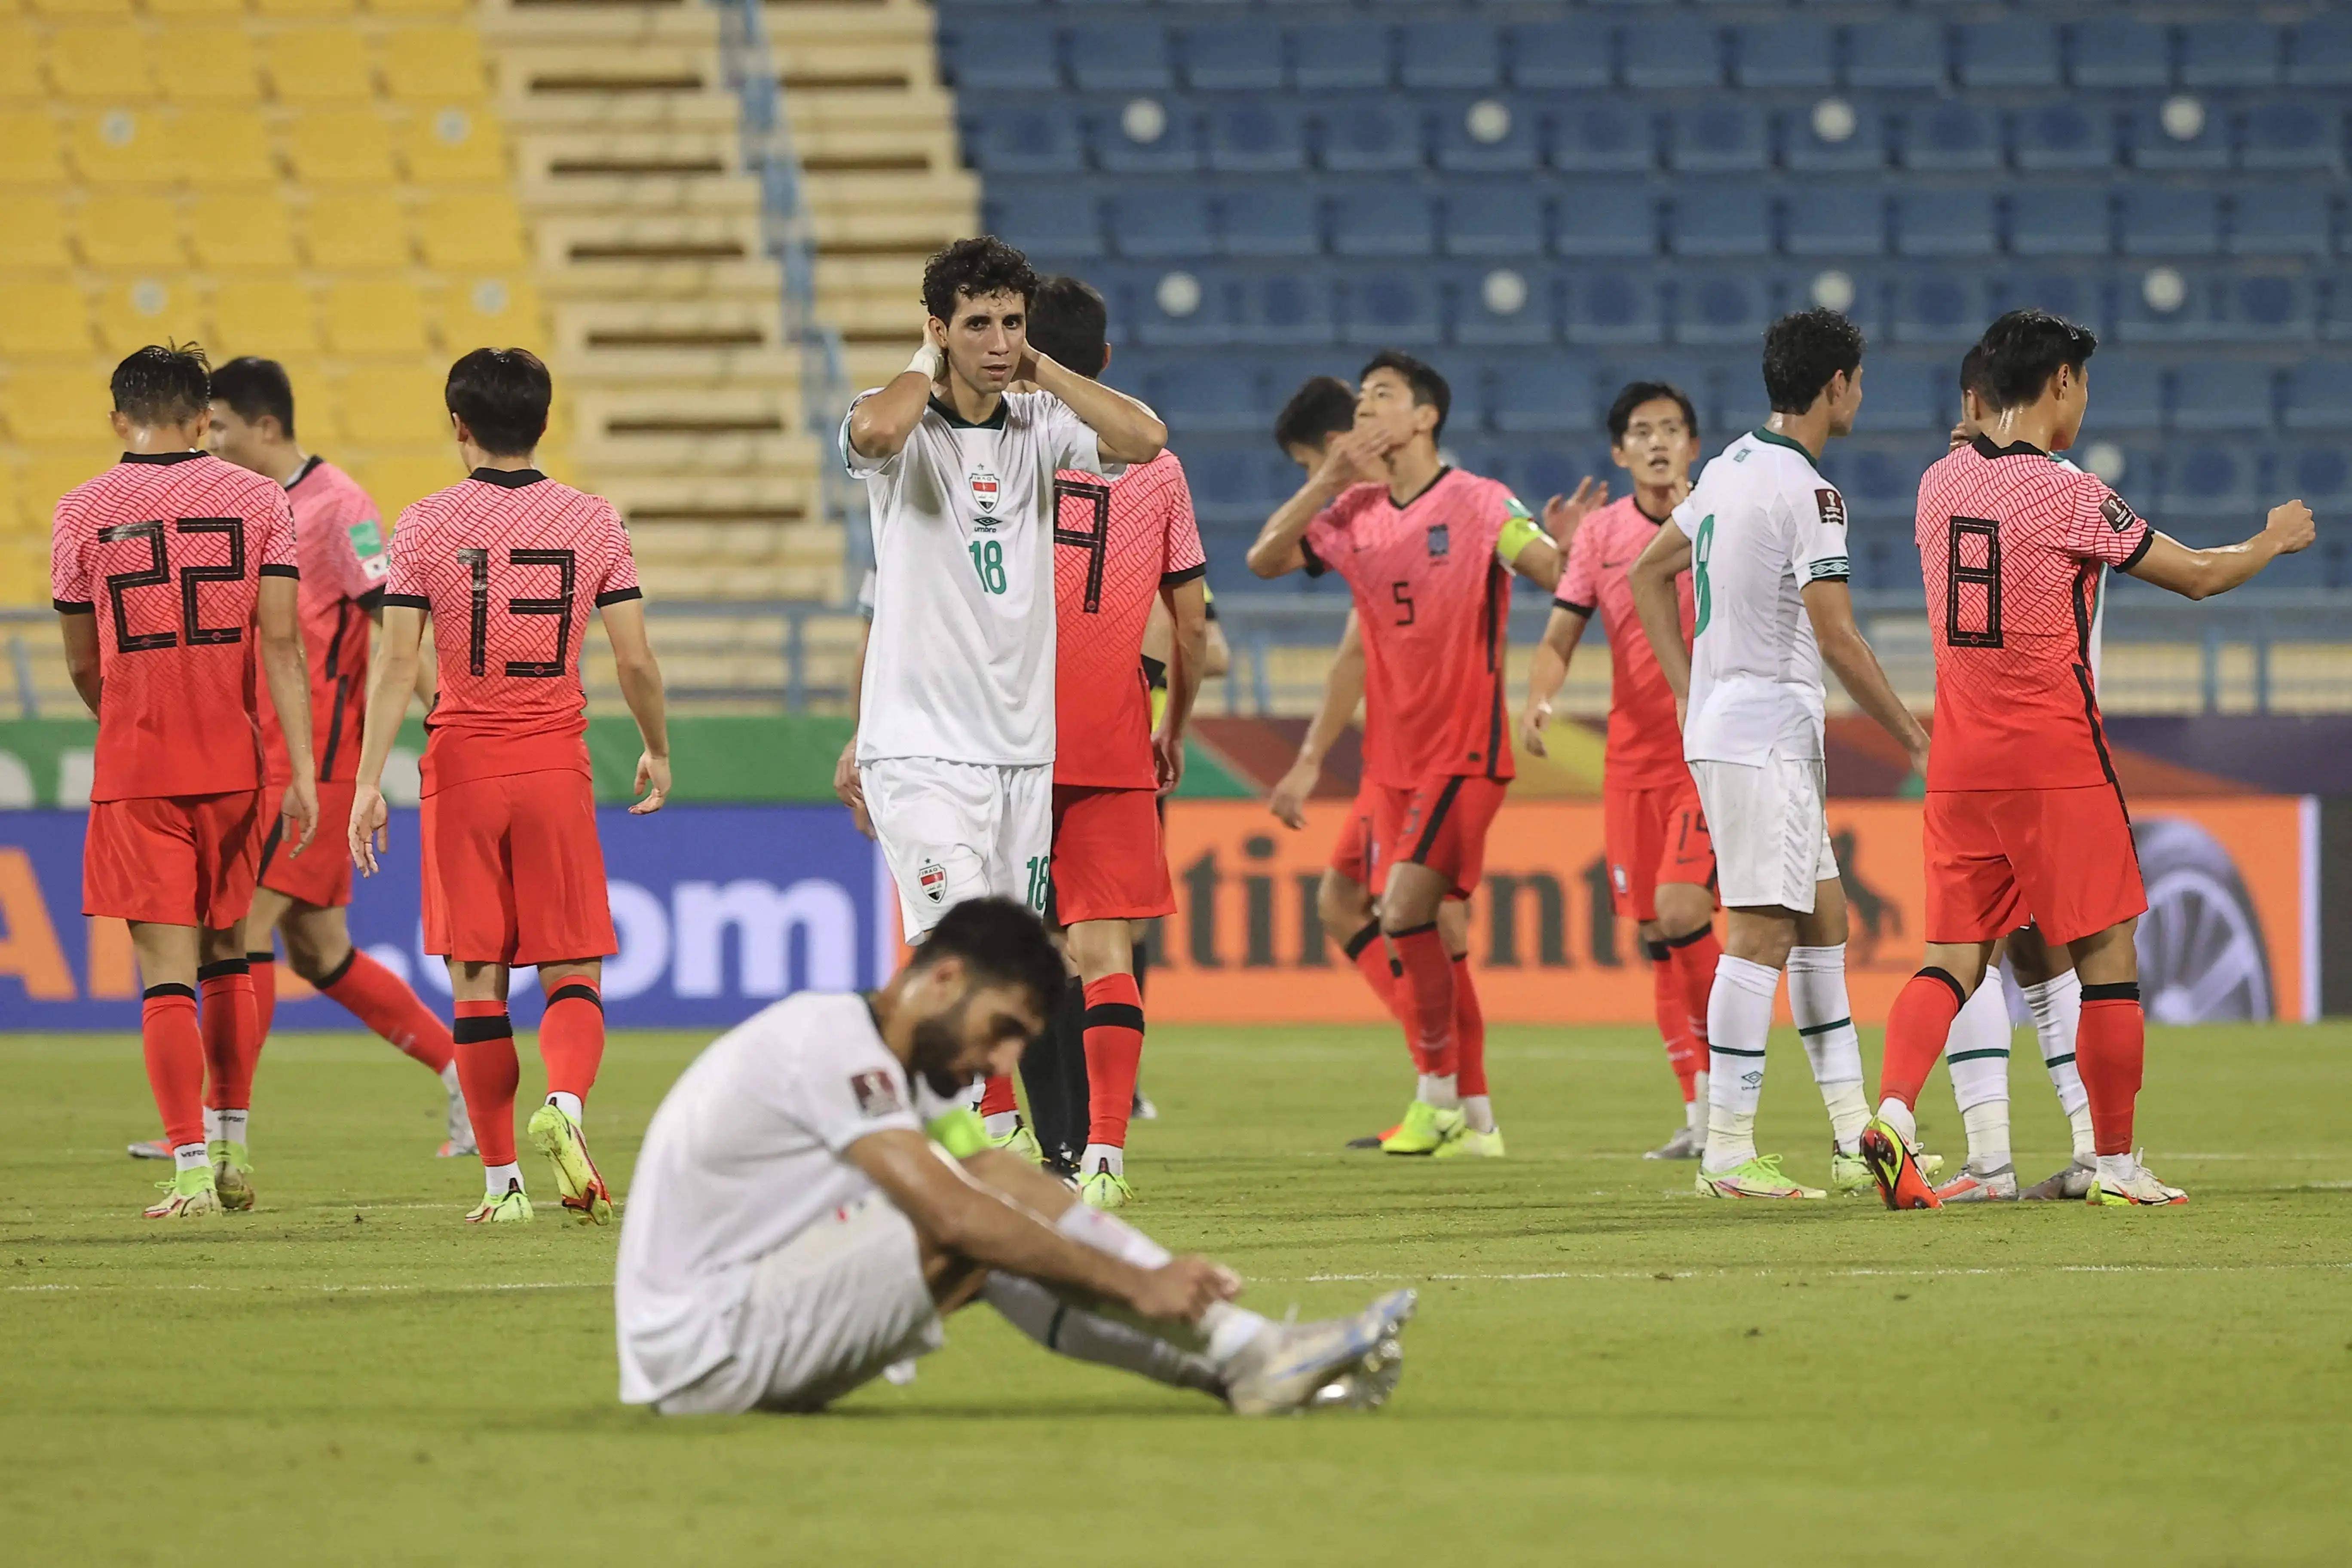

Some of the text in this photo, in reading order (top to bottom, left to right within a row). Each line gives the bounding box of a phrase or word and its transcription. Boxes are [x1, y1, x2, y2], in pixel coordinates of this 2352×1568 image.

[98, 518, 244, 653] 22
[457, 548, 575, 677] 13
[968, 540, 1007, 594] 18
[1392, 581, 1415, 626] 5
[1947, 516, 2004, 649] 8
[1026, 856, 1049, 910] 18
